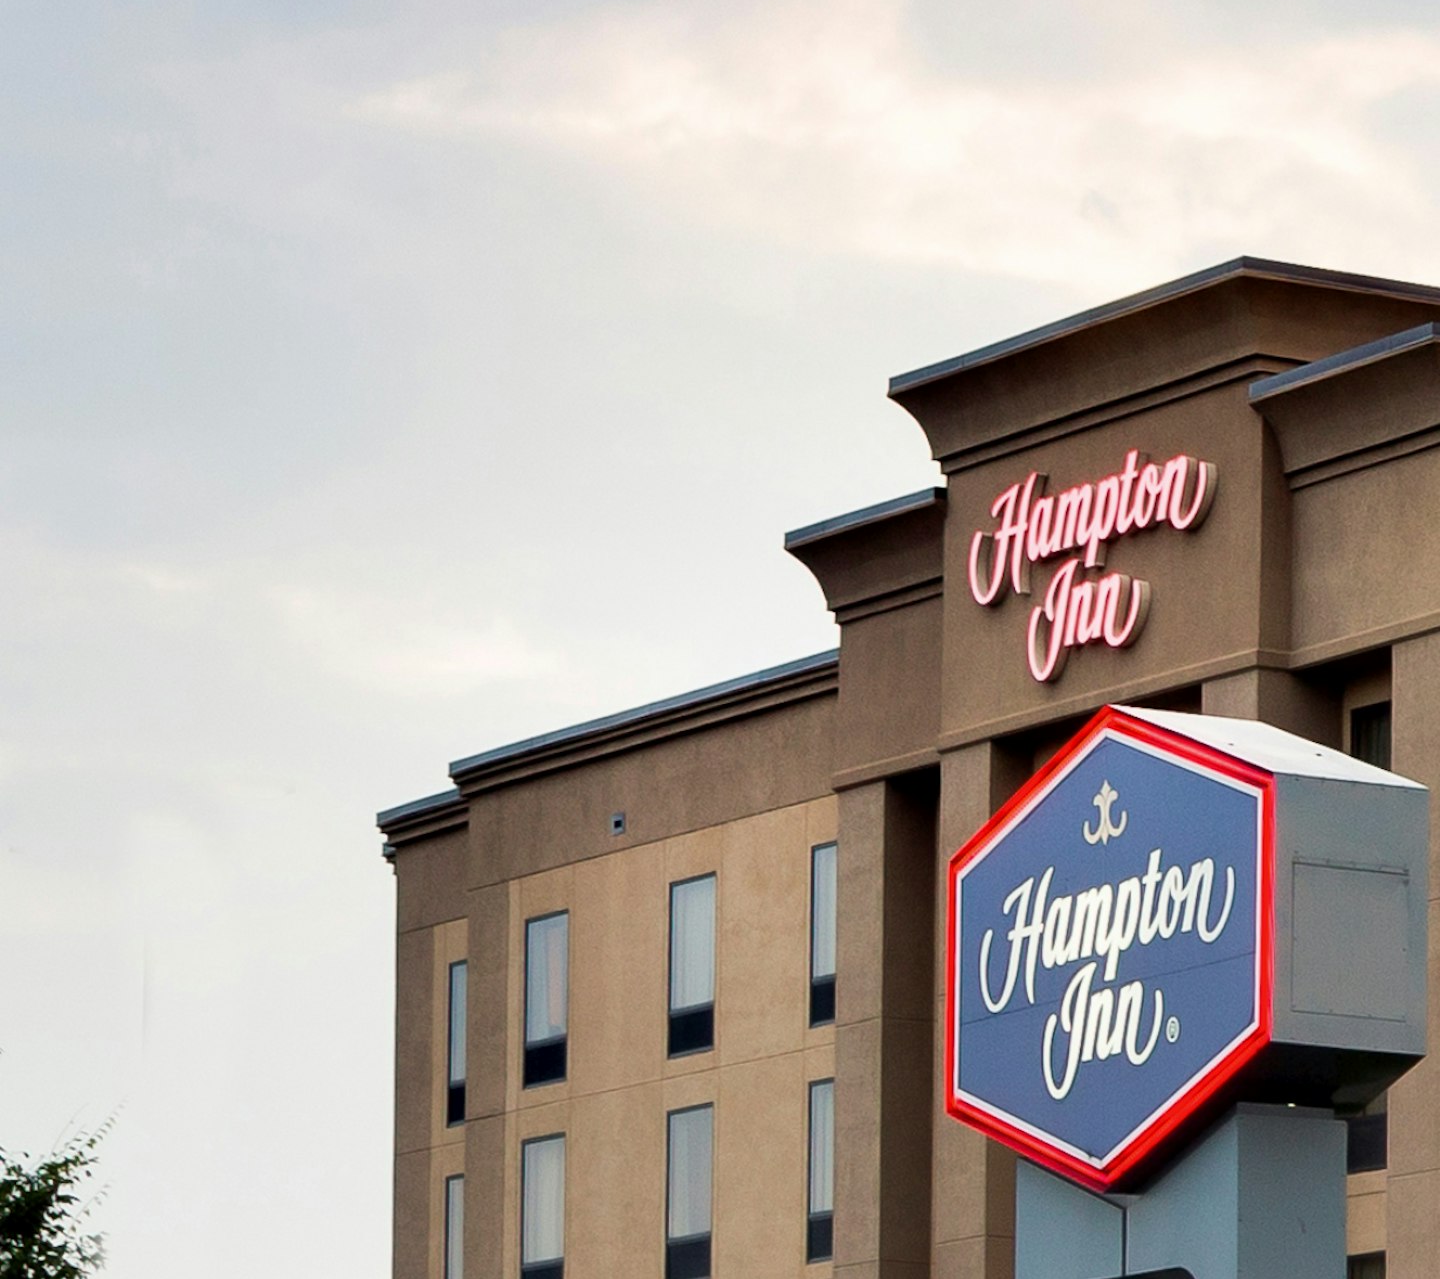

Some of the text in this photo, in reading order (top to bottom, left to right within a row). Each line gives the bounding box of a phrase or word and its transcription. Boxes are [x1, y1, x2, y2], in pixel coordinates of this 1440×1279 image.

[969, 449, 1211, 606] Hampton
[1027, 558, 1145, 682] Inn
[979, 848, 1235, 1013] Hampton
